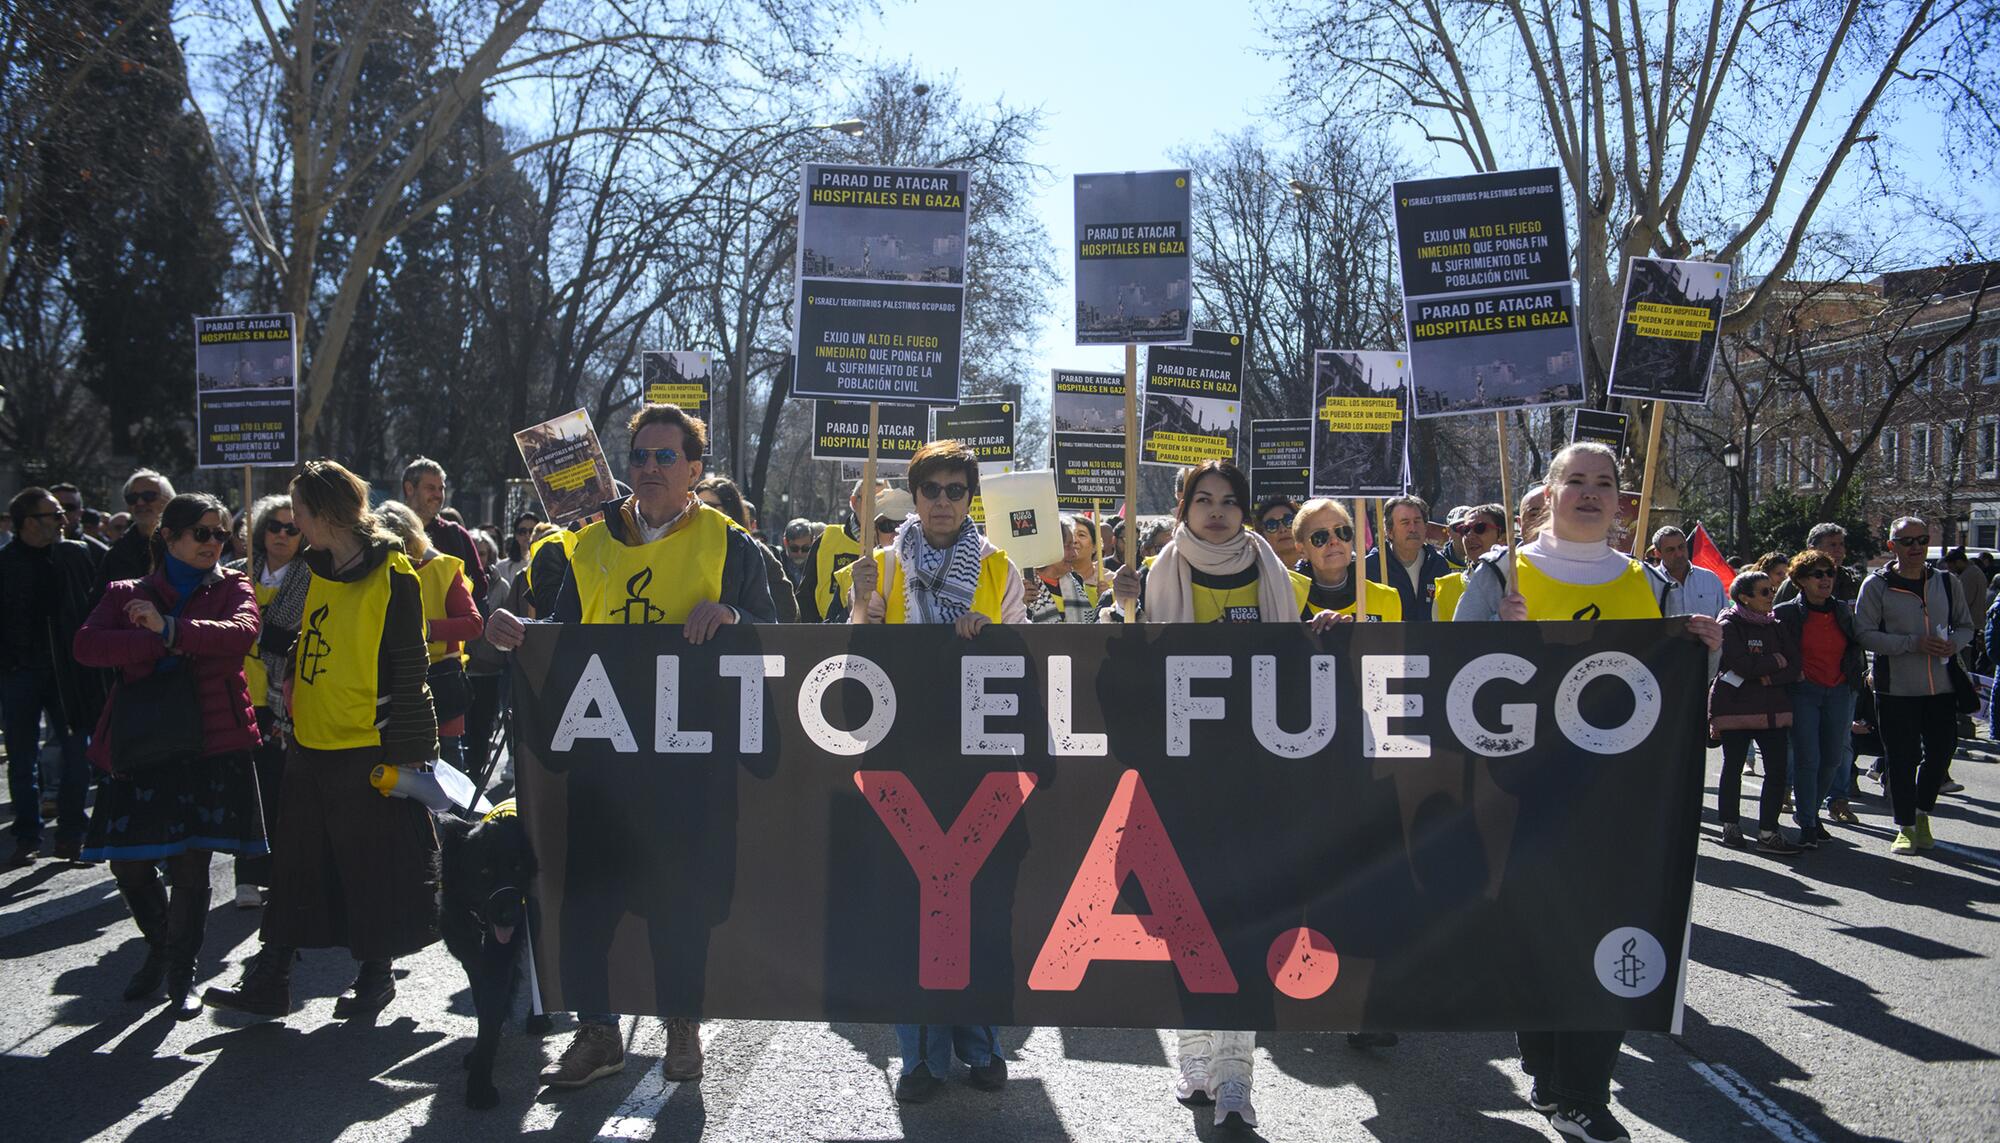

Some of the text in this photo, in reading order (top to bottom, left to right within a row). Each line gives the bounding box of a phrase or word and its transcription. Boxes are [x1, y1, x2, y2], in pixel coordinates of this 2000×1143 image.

[822, 173, 949, 190] PARAD DE ATACAR
[813, 190, 960, 208] HOSPITALES EN GAZA
[1409, 185, 1553, 206] ISRAEL/ TERRITORIOS PALESTINOS OCUPADOS
[1088, 226, 1175, 240] PARAD DE ATACAR
[1424, 221, 1542, 243] EXIJO UN ALTO EL FUEGO
[1082, 241, 1184, 256] HOSPITALES EN GAZA
[1418, 236, 1548, 259] INMEDIATO QUE PONGA FIN
[1431, 253, 1541, 273] AL SUFRIMIENTO DE LA
[1446, 269, 1530, 287] POBLACIÓN CIVIL
[815, 297, 955, 312] ISRAEL/ TERRITORIOS PALESTINOS OCUPADOS
[1423, 295, 1553, 320] PARAD DE ATACAR
[1629, 313, 1636, 321] NO
[1639, 315, 1662, 324] PUEDEN
[1663, 317, 1674, 325] SER
[1674, 308, 1706, 317] HOSPITALES
[206, 320, 281, 331] PARAD DE ATACAR
[1416, 310, 1568, 337] HOSPITALES EN GAZA
[201, 329, 289, 343] HOSPITALES EN GAZA
[824, 331, 938, 348] EXIJO UN ALTO EL FUEGO
[816, 346, 941, 363] INMEDIATO QUE PONGA FIN
[826, 362, 932, 377] AL SUFRIMIENTO DE LA
[1158, 364, 1231, 380] PARAD DE ATACAR
[838, 376, 919, 392] POBLACIÓN CIVIL
[1061, 374, 1083, 383] PARAD
[1085, 376, 1093, 384] DE
[1152, 376, 1237, 392] HOSPITALES EN GAZA
[1058, 384, 1097, 392] HOSPITALES
[1321, 410, 1329, 418] NO
[1330, 410, 1352, 418] PUEDEN
[1353, 410, 1364, 418] SER
[827, 422, 859, 434] PARAD
[878, 425, 914, 436] ATACAR
[1353, 421, 1363, 430] LOS
[882, 439, 894, 449] EN
[898, 440, 922, 451] GAZA
[968, 437, 977, 445] DE
[979, 436, 1004, 445] ATACAR
[1178, 434, 1188, 442] LOS
[1190, 436, 1224, 445] HOSPITALES
[993, 446, 1010, 455] GAZA
[1180, 454, 1191, 462] LOS
[551, 651, 1661, 759] ALTO EL FUEGO
[854, 769, 1340, 999] YA.
